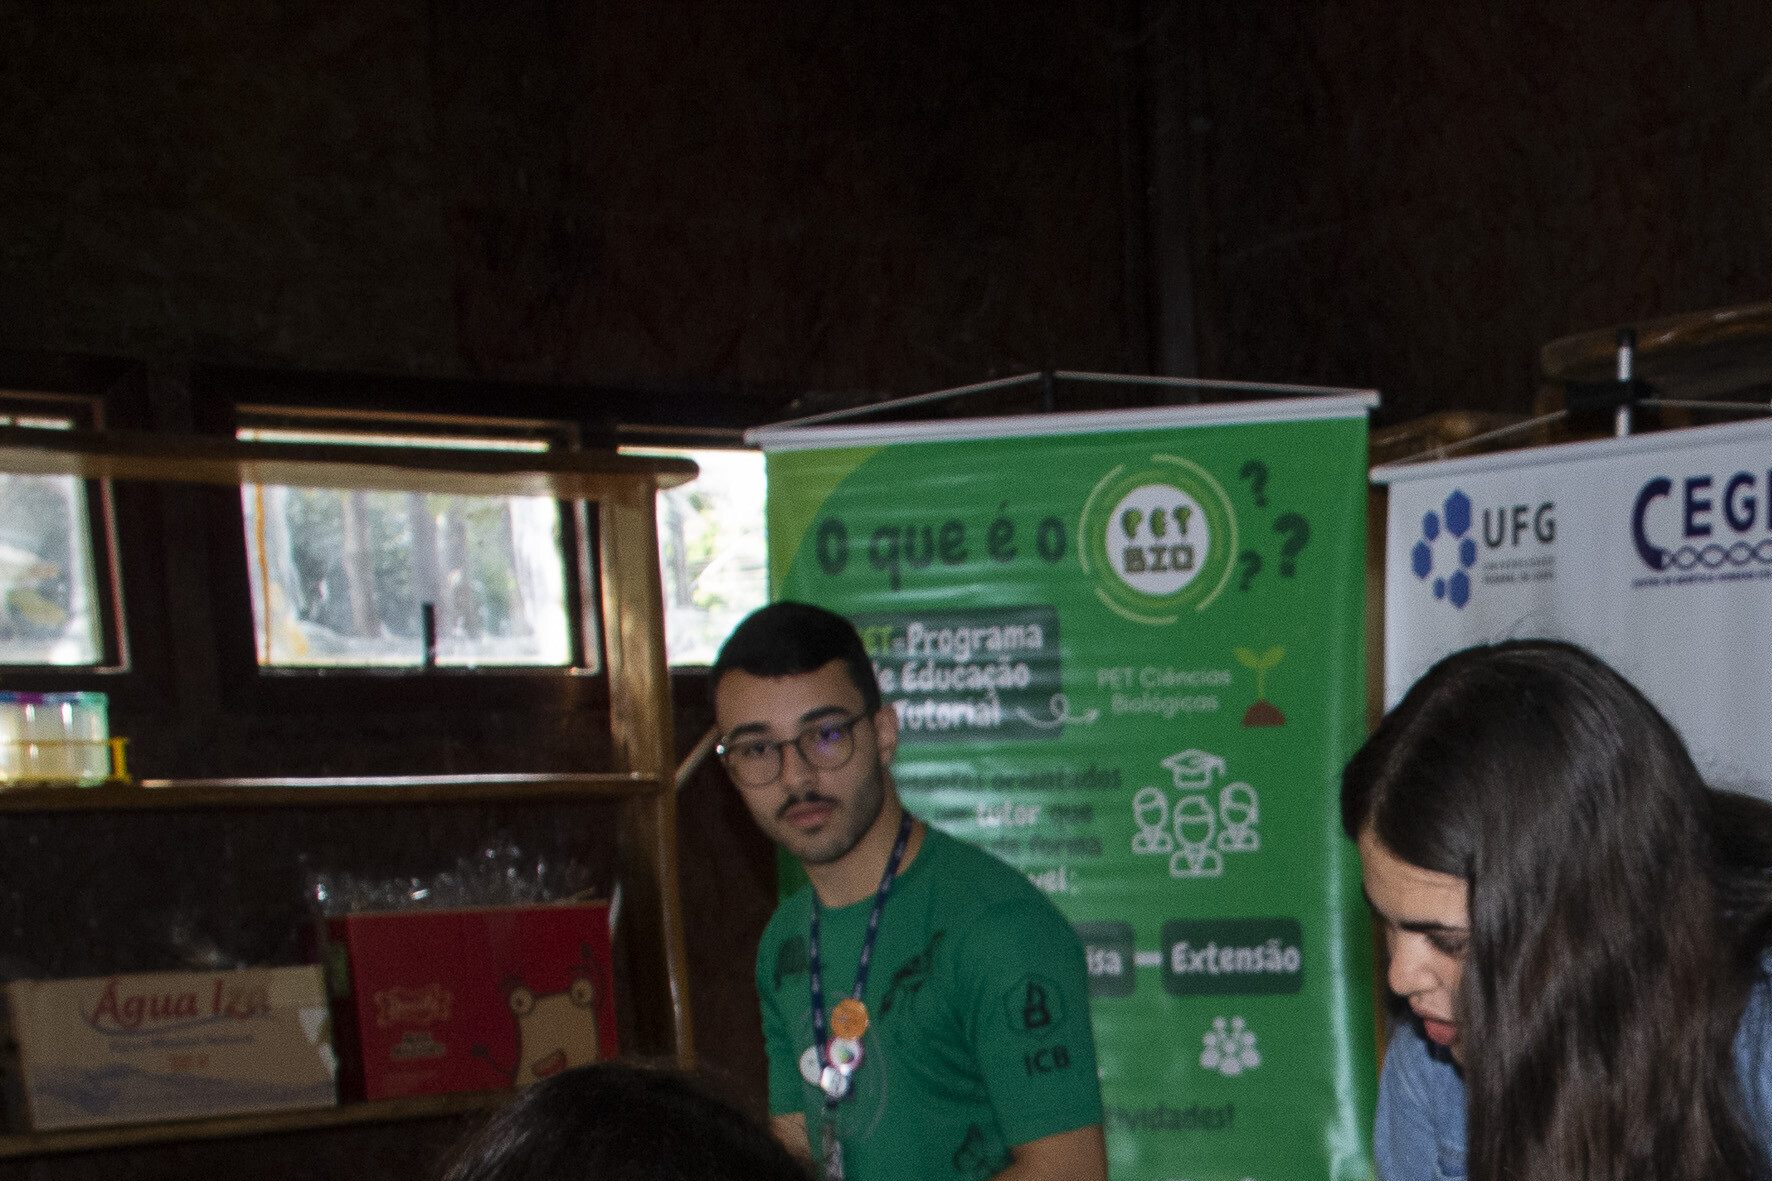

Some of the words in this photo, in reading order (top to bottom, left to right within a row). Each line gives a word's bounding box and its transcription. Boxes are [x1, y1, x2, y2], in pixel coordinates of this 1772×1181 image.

[1122, 506, 1193, 538] PET
[1483, 501, 1556, 549] UFG
[816, 516, 849, 576] O
[868, 518, 968, 592] que
[987, 501, 1017, 563] é
[1036, 516, 1067, 562] o
[1123, 545, 1195, 573] BIO
[860, 625, 894, 657] ET
[906, 620, 1044, 664] Programa
[901, 655, 1032, 699] Educação
[976, 800, 1042, 828] tutor
[1171, 937, 1301, 976] Extensão
[1023, 1045, 1071, 1077] ICB
